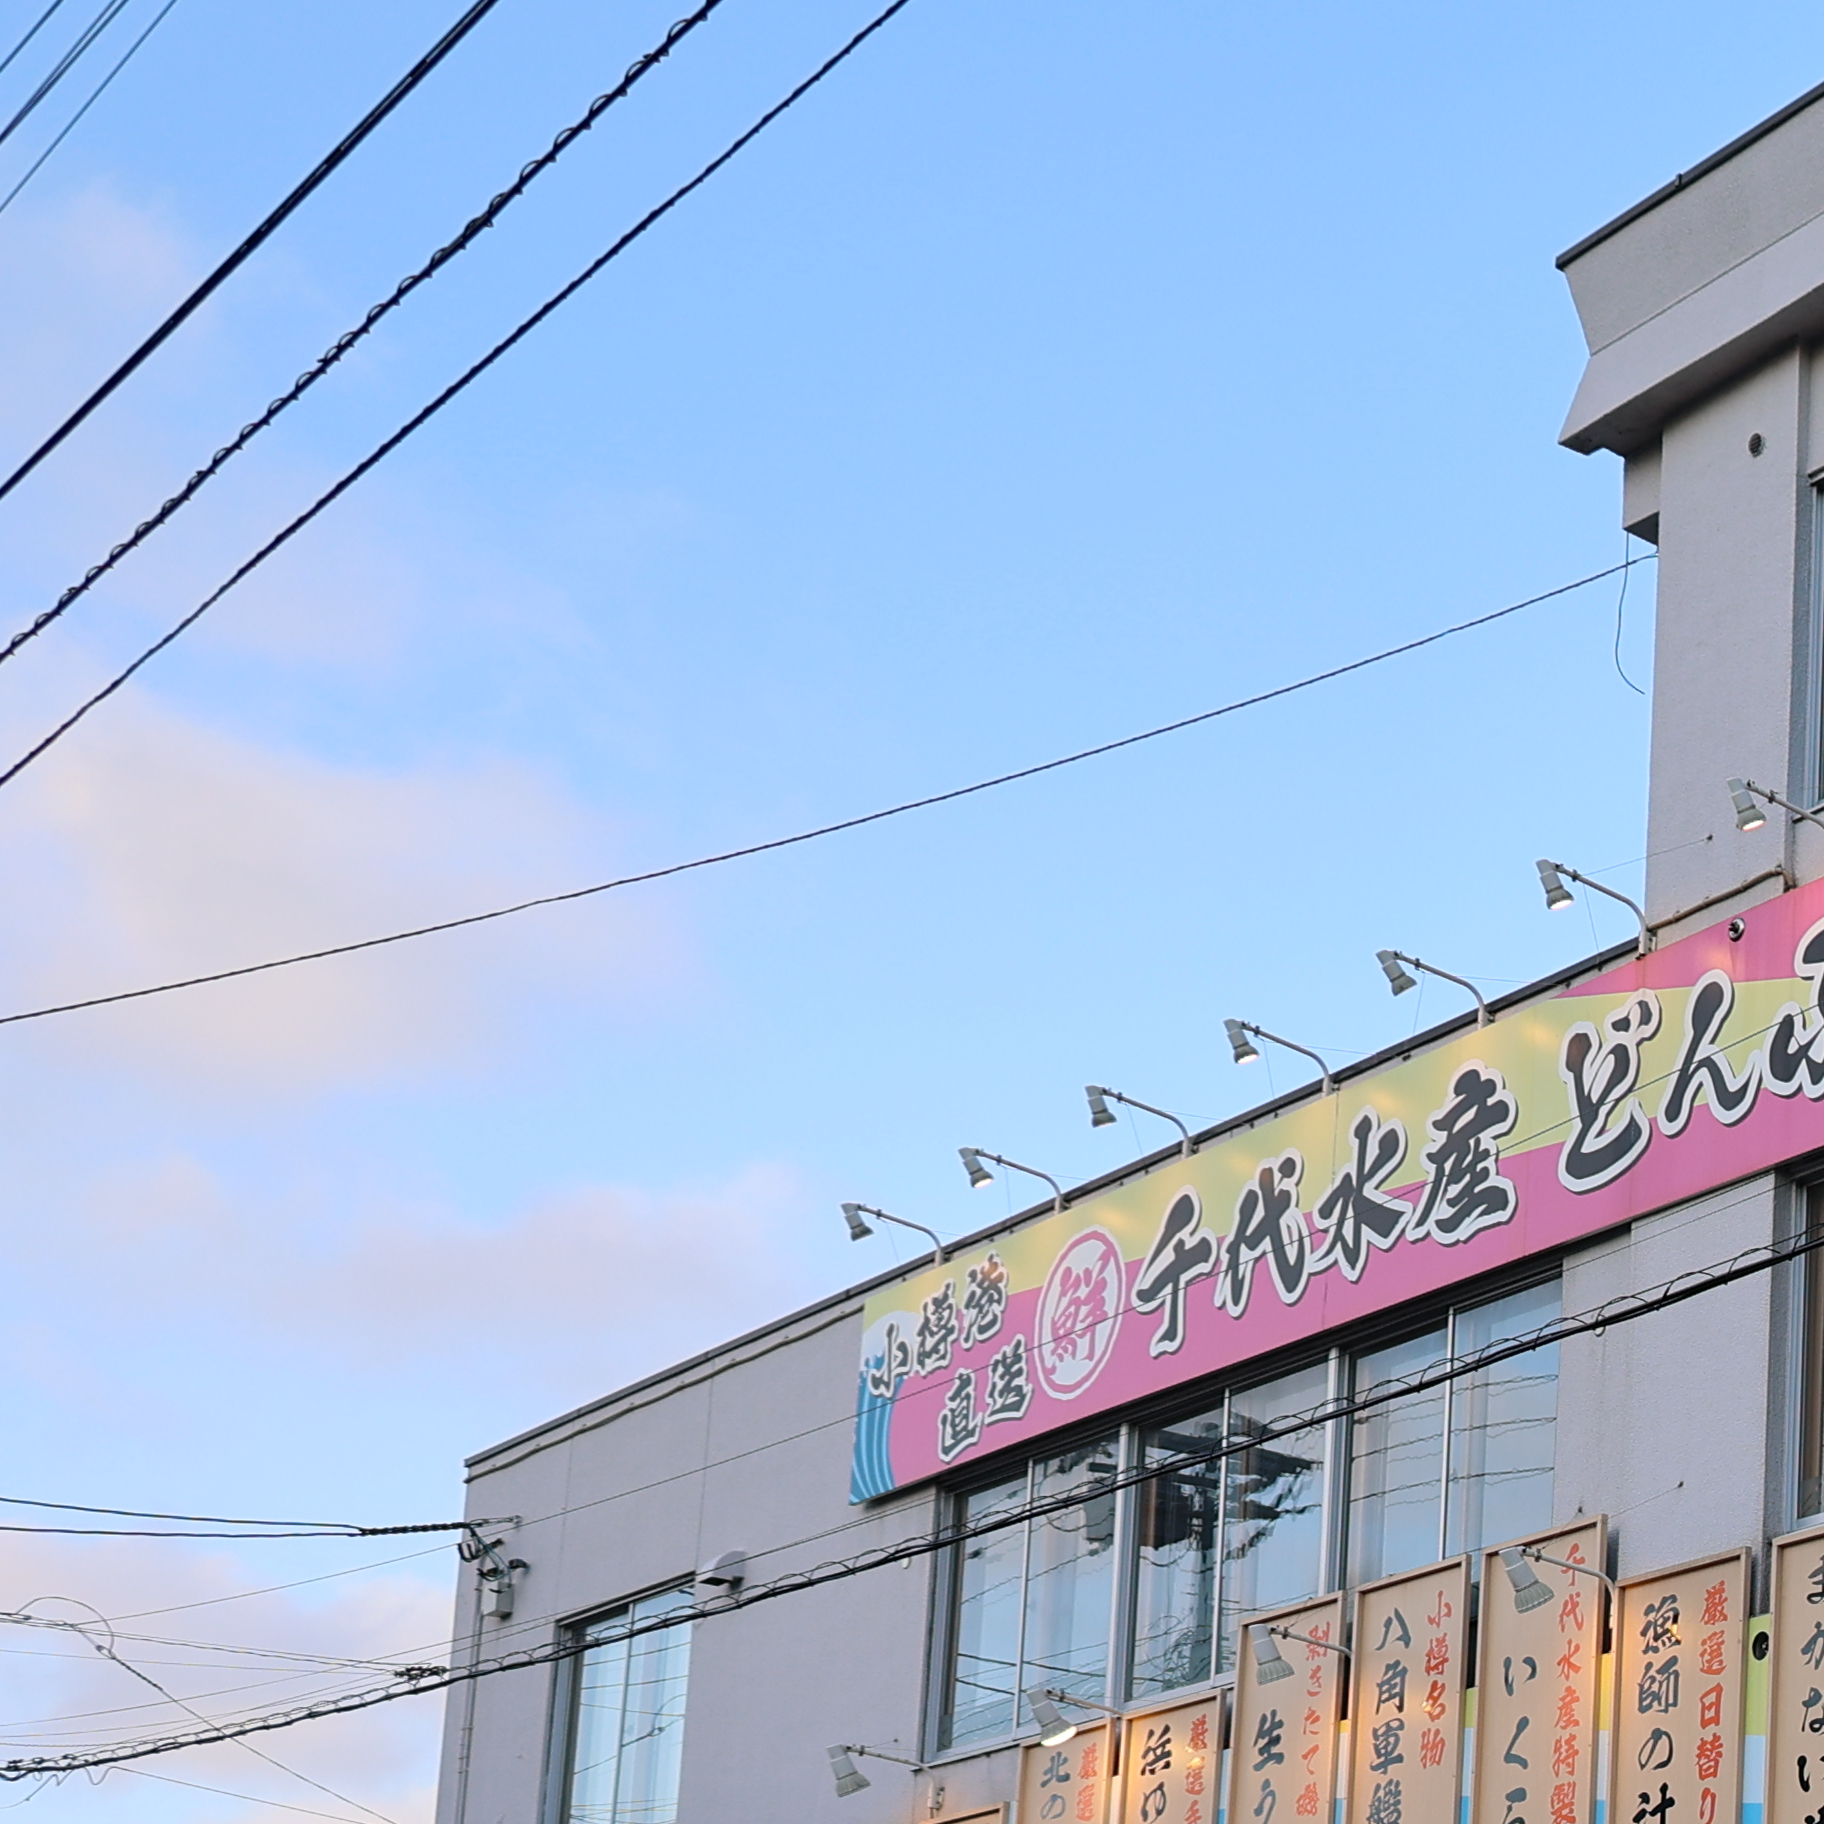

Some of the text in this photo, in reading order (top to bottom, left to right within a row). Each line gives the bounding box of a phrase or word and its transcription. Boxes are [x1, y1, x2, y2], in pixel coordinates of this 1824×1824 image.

[1138, 1066, 1515, 1354] 千代水産
[869, 1255, 1007, 1397] 小樽港
[938, 1336, 1033, 1461] 直送
[1419, 1591, 1452, 1770] 小樽名物
